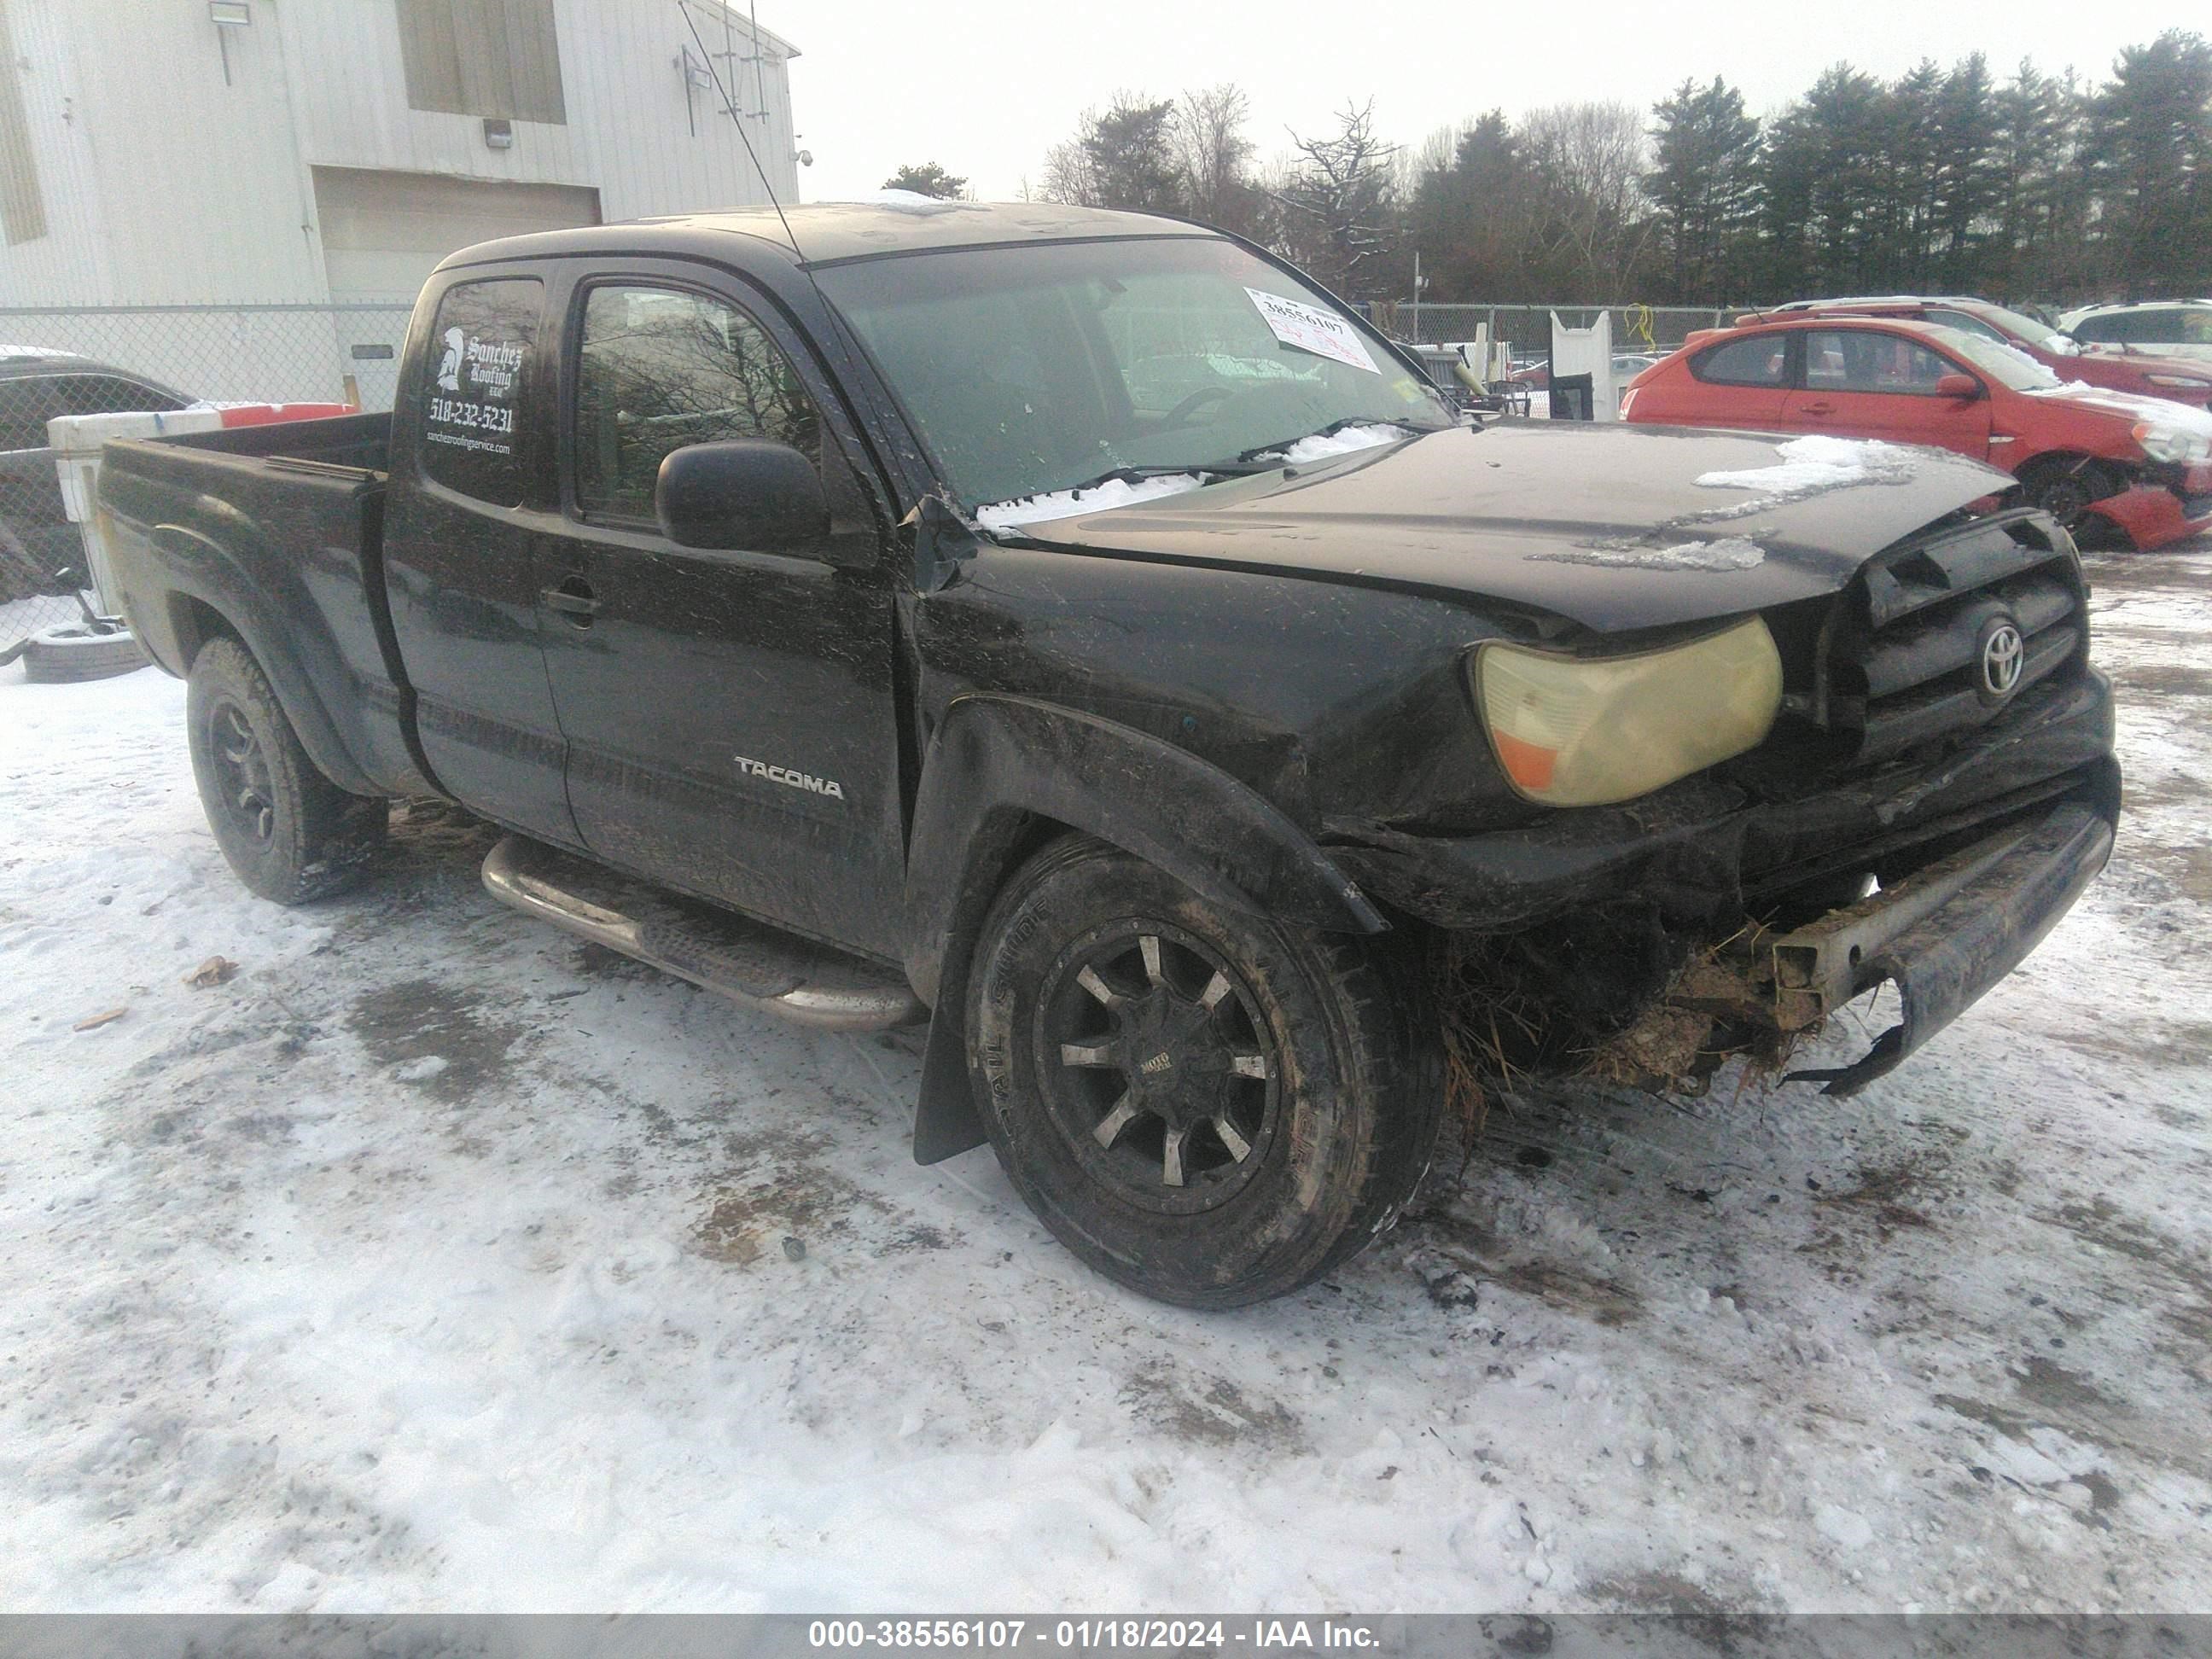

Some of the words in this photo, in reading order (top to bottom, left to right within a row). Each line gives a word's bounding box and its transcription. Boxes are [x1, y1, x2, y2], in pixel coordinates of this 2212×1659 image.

[1263, 301, 1344, 335] 38556107
[466, 337, 523, 371] Sanchez
[470, 363, 512, 390] Roofing
[429, 398, 512, 433] 518-232-5231
[427, 431, 510, 454] sanchezroofingservice.com
[734, 756, 844, 800] TACOMA
